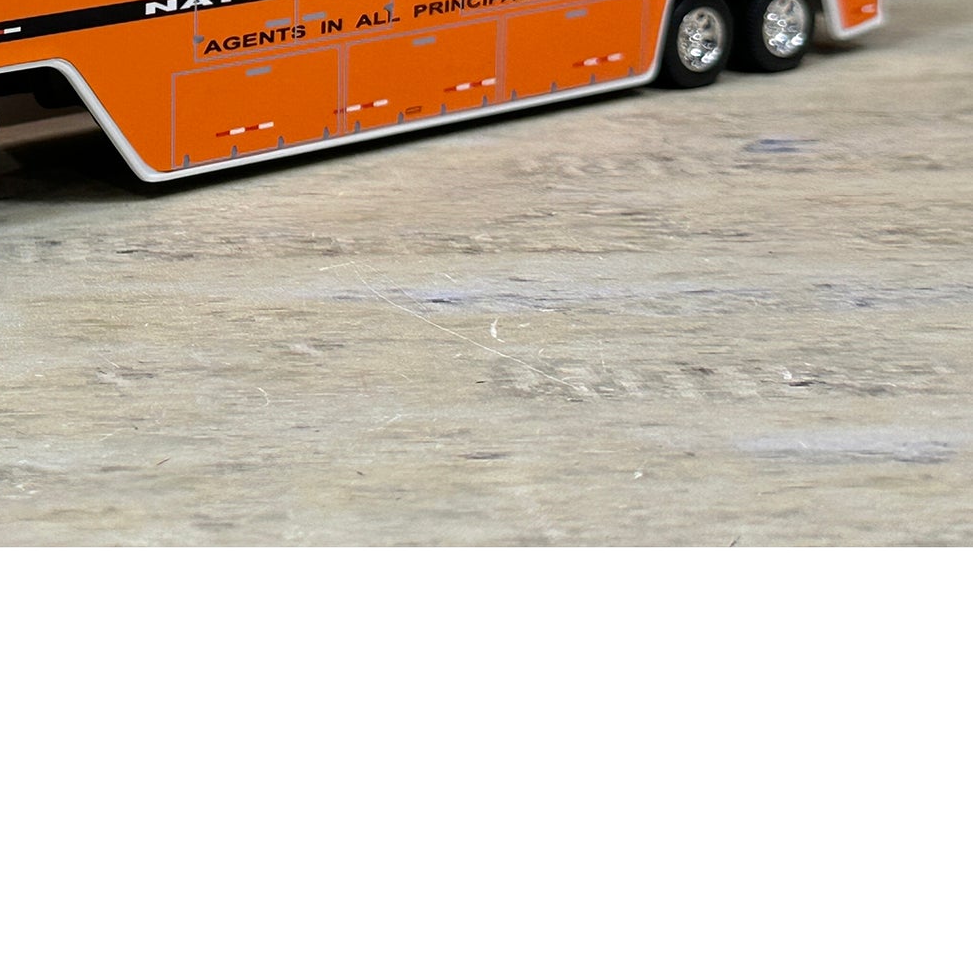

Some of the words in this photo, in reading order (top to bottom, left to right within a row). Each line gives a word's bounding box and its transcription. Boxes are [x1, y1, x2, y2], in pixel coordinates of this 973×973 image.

[204, 26, 307, 55] AGENTS
[320, 18, 343, 35] IN
[355, 9, 400, 27] ALL
